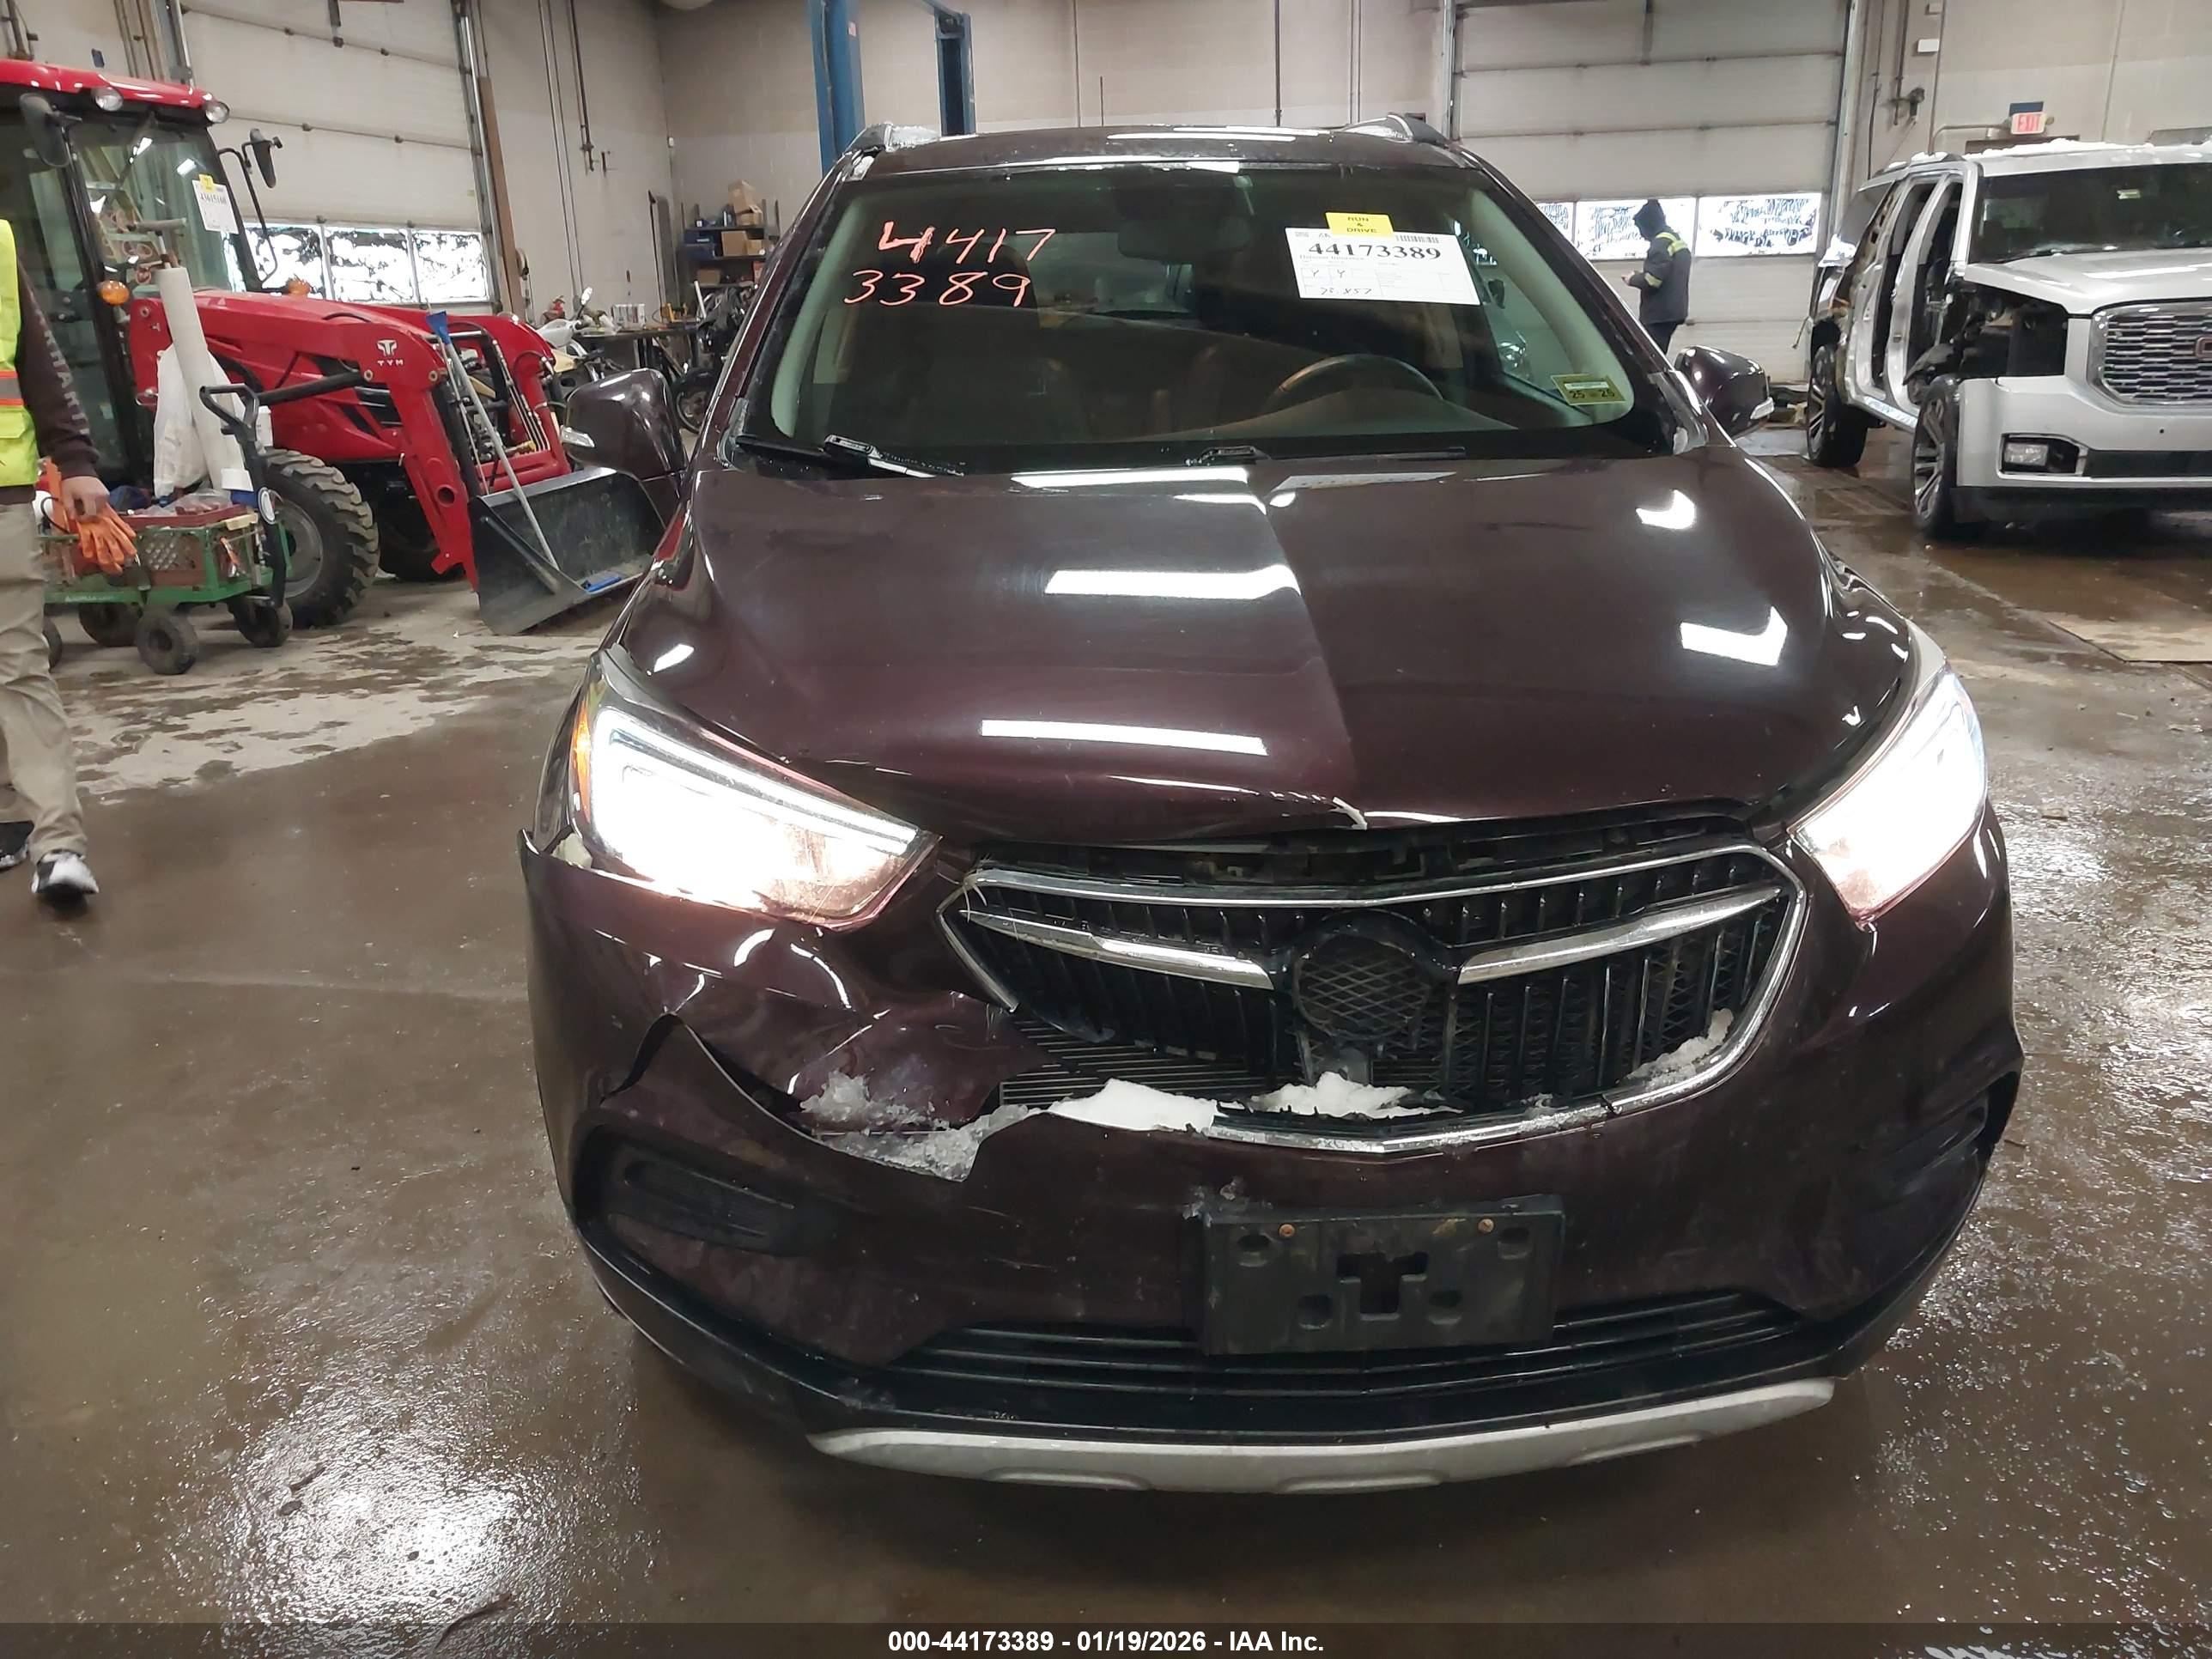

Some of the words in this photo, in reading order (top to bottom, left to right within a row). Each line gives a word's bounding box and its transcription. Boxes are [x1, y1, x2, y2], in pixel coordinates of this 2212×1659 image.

[878, 221, 1056, 264] 4417
[1309, 243, 1441, 259] 44173389
[844, 270, 1030, 307] 3389
